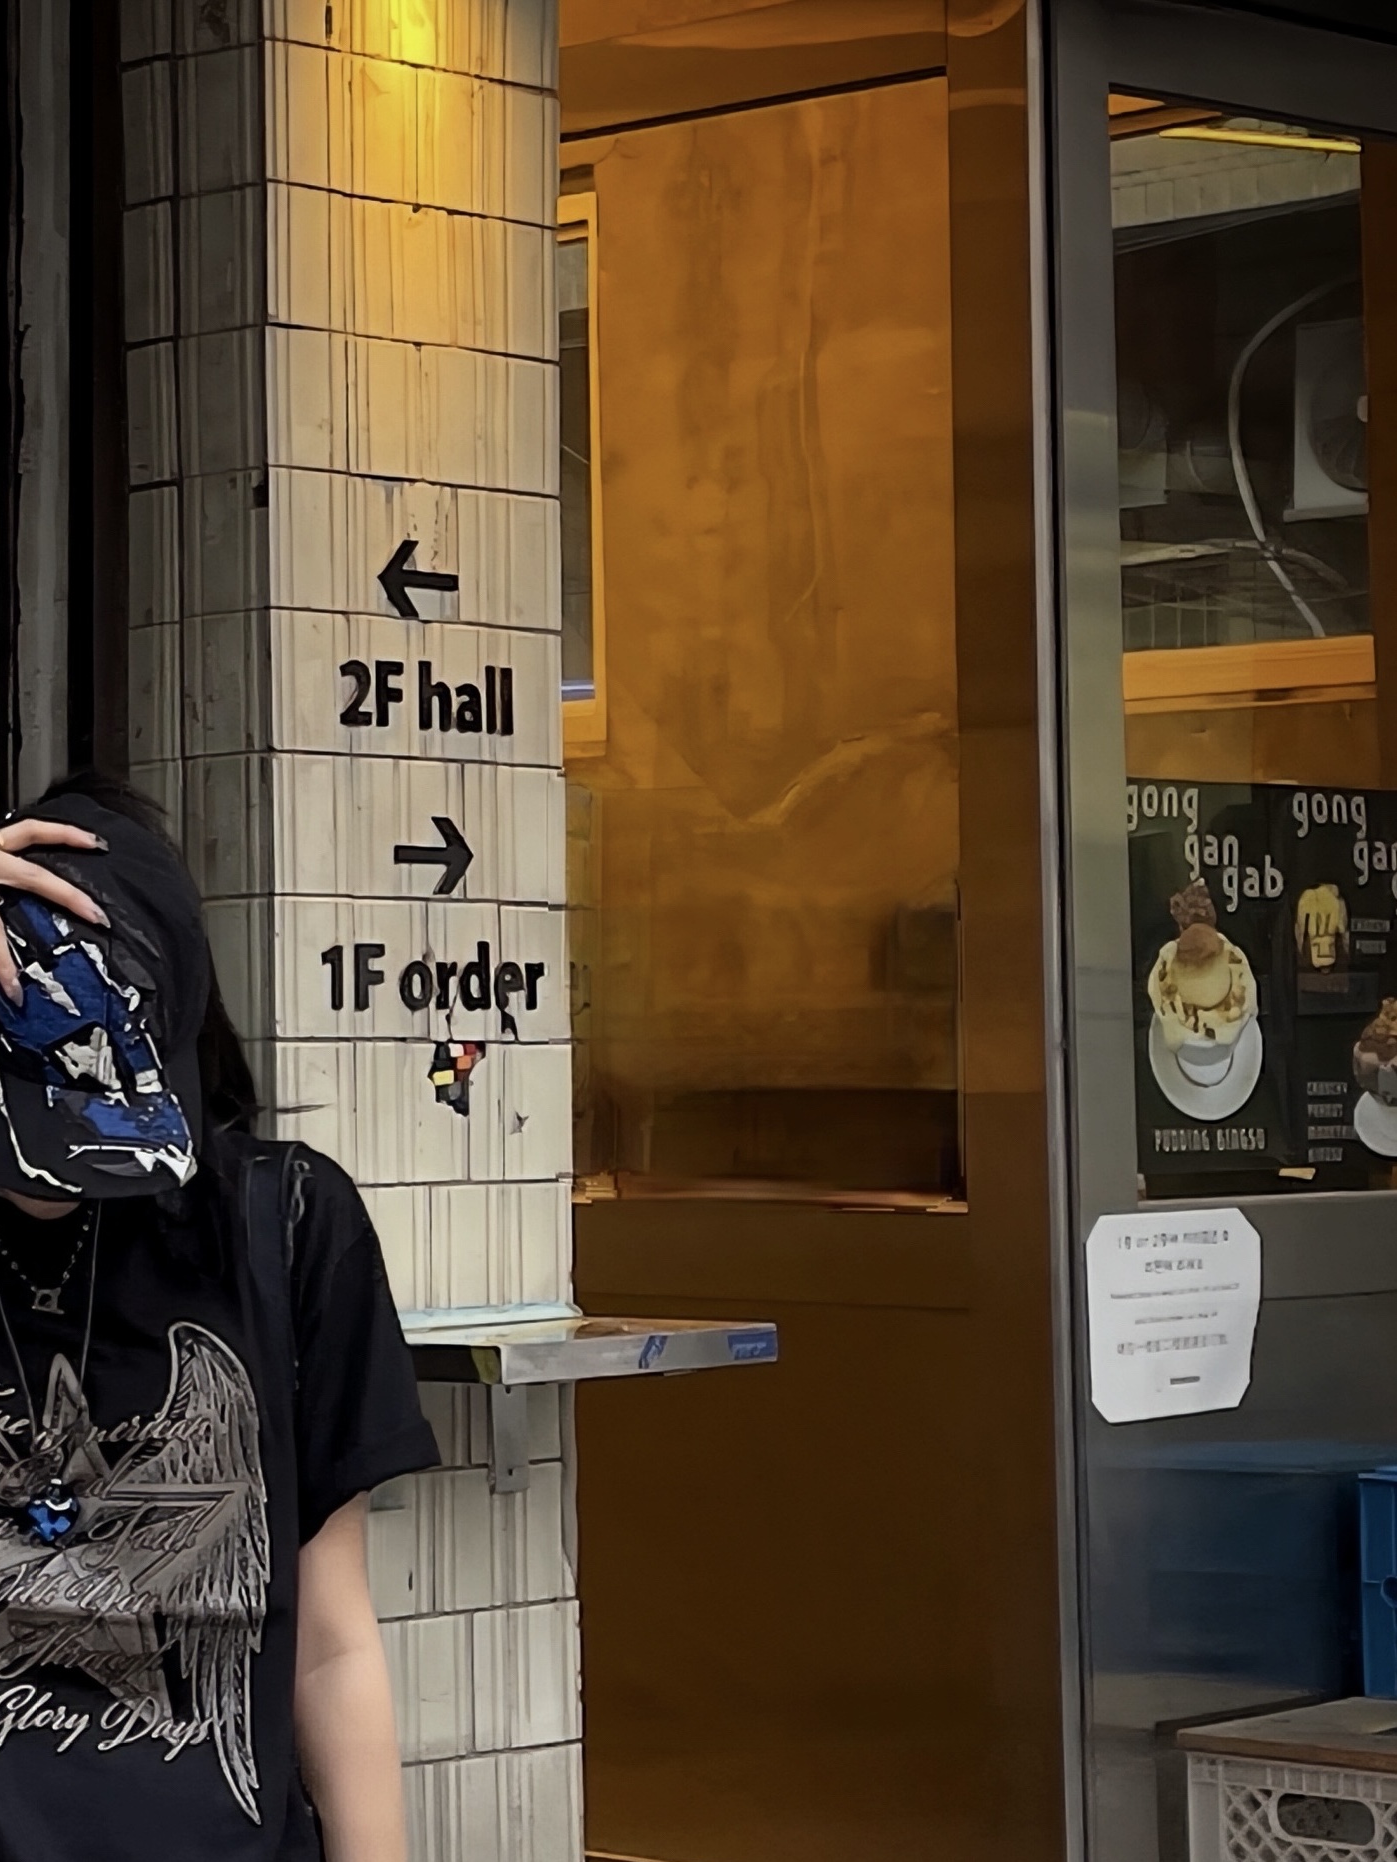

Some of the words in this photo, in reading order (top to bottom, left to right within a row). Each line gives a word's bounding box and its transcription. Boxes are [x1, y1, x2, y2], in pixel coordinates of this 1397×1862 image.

[339, 659, 404, 728] 2F
[418, 660, 514, 736] hall
[1292, 791, 1367, 839] gong
[1184, 834, 1240, 881] gan
[1222, 855, 1285, 913] gab
[321, 942, 386, 1012] 1F
[400, 941, 545, 1013] order
